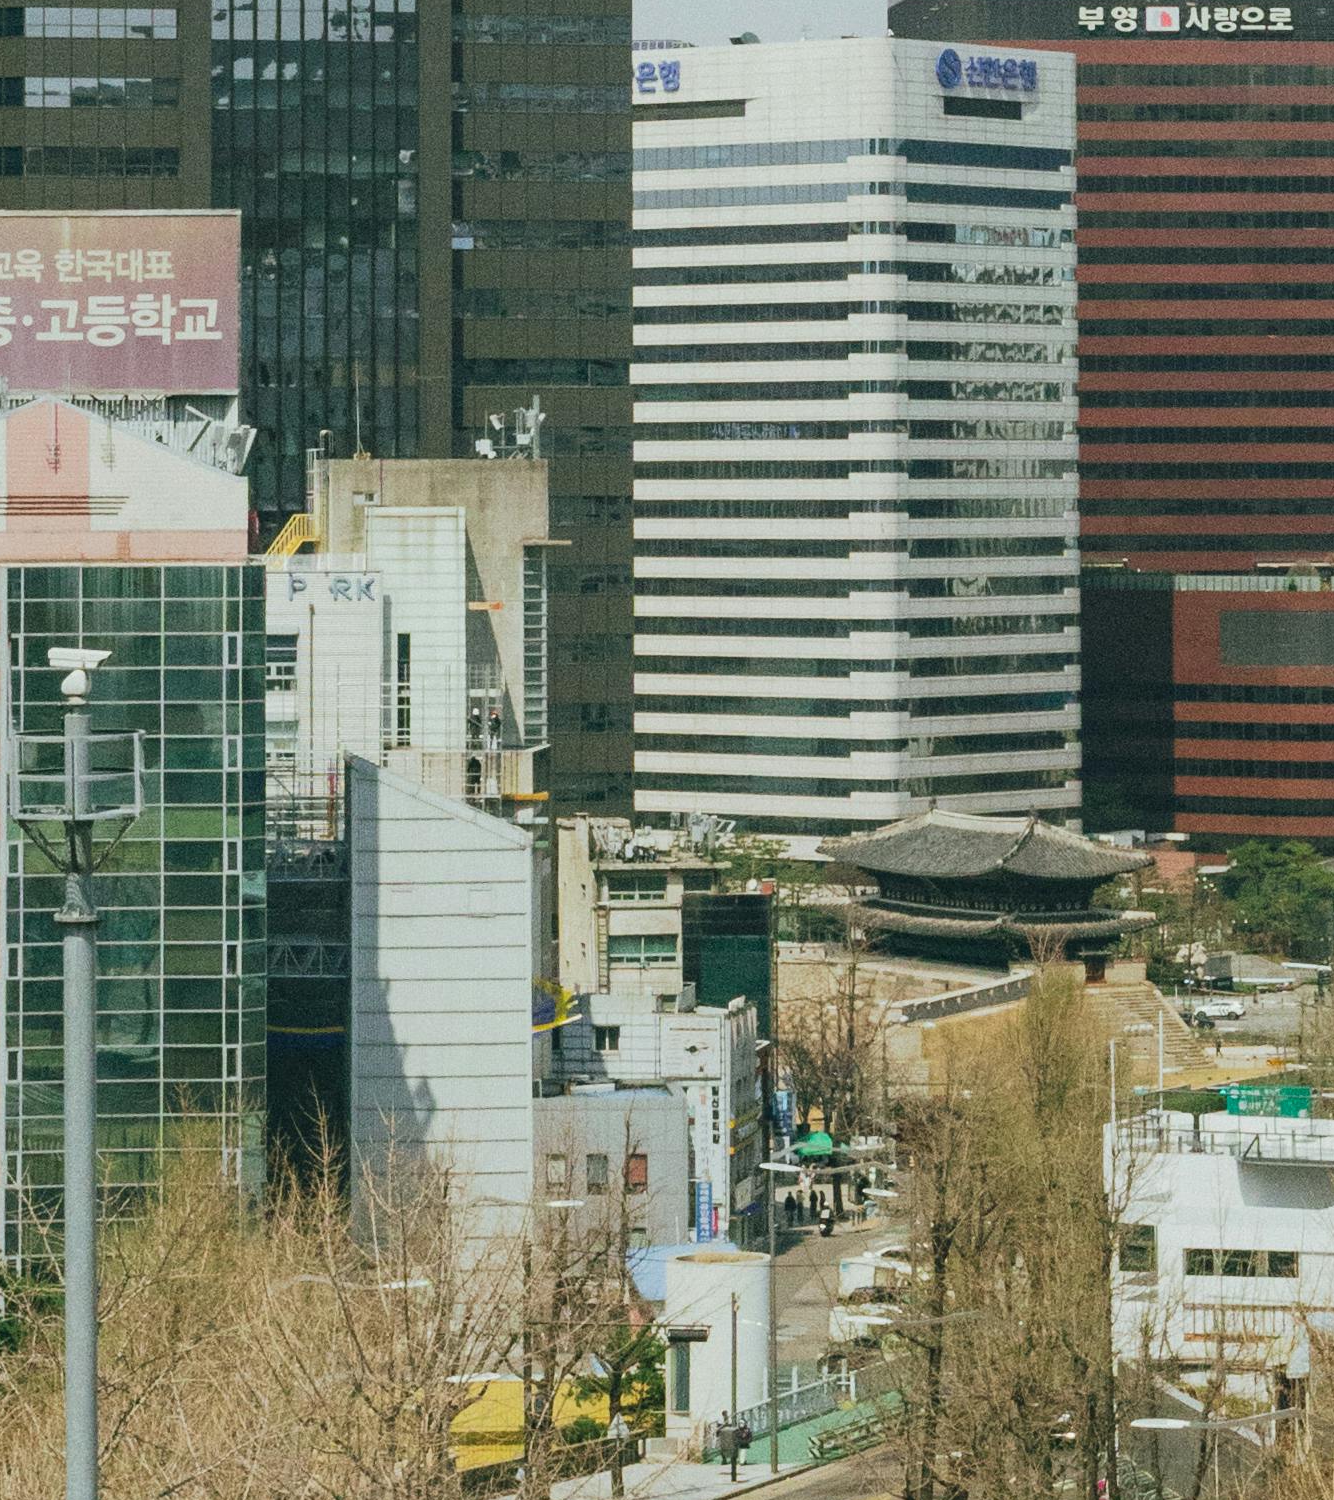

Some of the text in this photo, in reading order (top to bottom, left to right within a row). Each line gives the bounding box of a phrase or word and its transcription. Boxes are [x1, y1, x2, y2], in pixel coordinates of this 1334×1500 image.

[1077, 6, 1295, 33] 부영 사랑으로
[636, 60, 681, 94] 은행
[965, 56, 1037, 92] 신한은행
[54, 248, 176, 284] 한국대표
